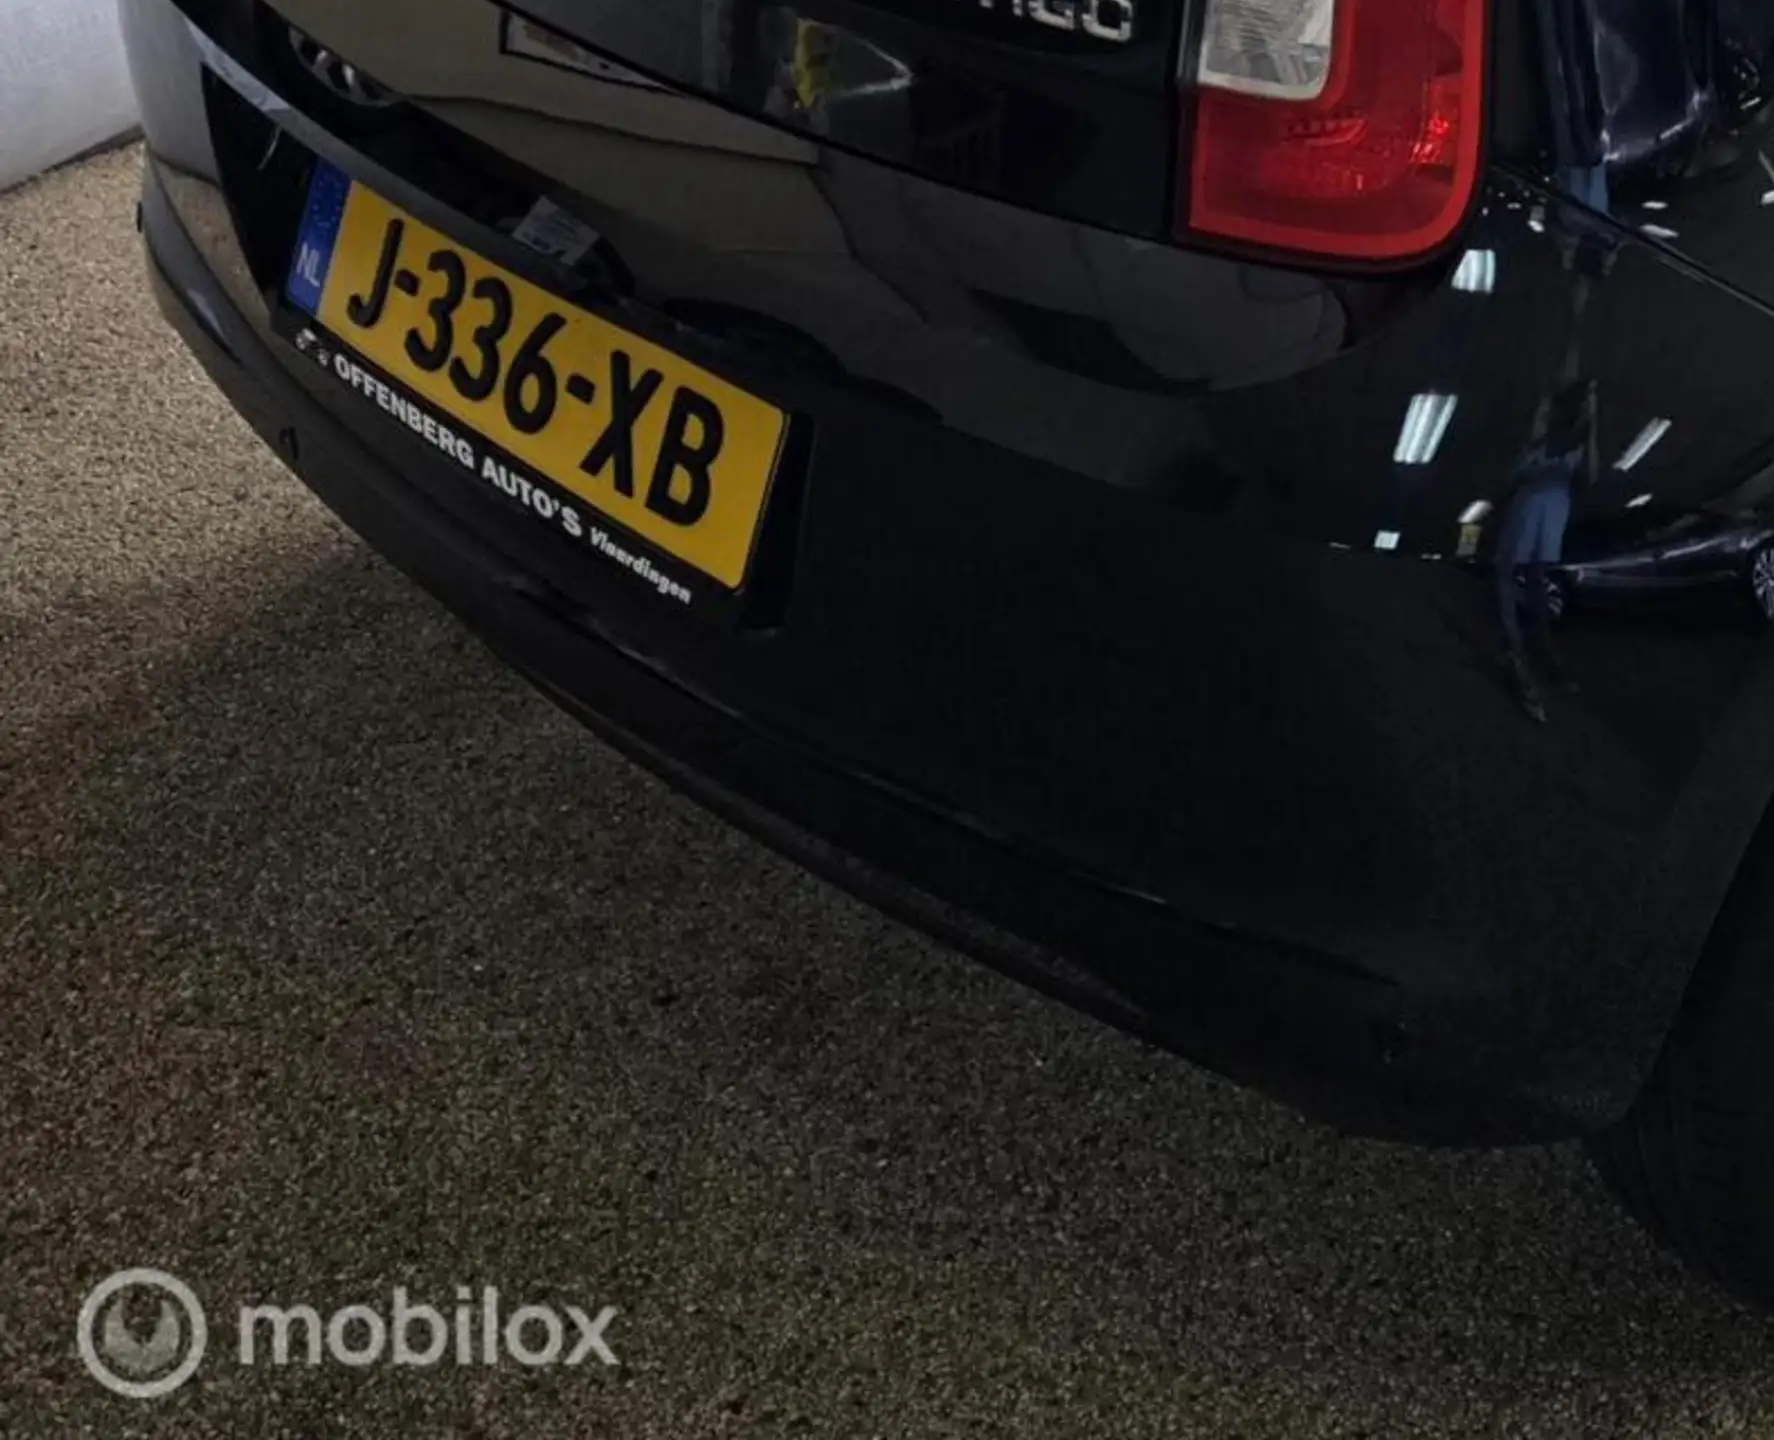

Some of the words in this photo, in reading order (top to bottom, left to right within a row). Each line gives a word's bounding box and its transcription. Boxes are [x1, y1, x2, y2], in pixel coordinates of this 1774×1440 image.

[296, 242, 321, 288] NL
[334, 353, 475, 469] OFFENBERG
[481, 455, 581, 537] AUTO'S
[346, 218, 724, 527] J-336-XB
